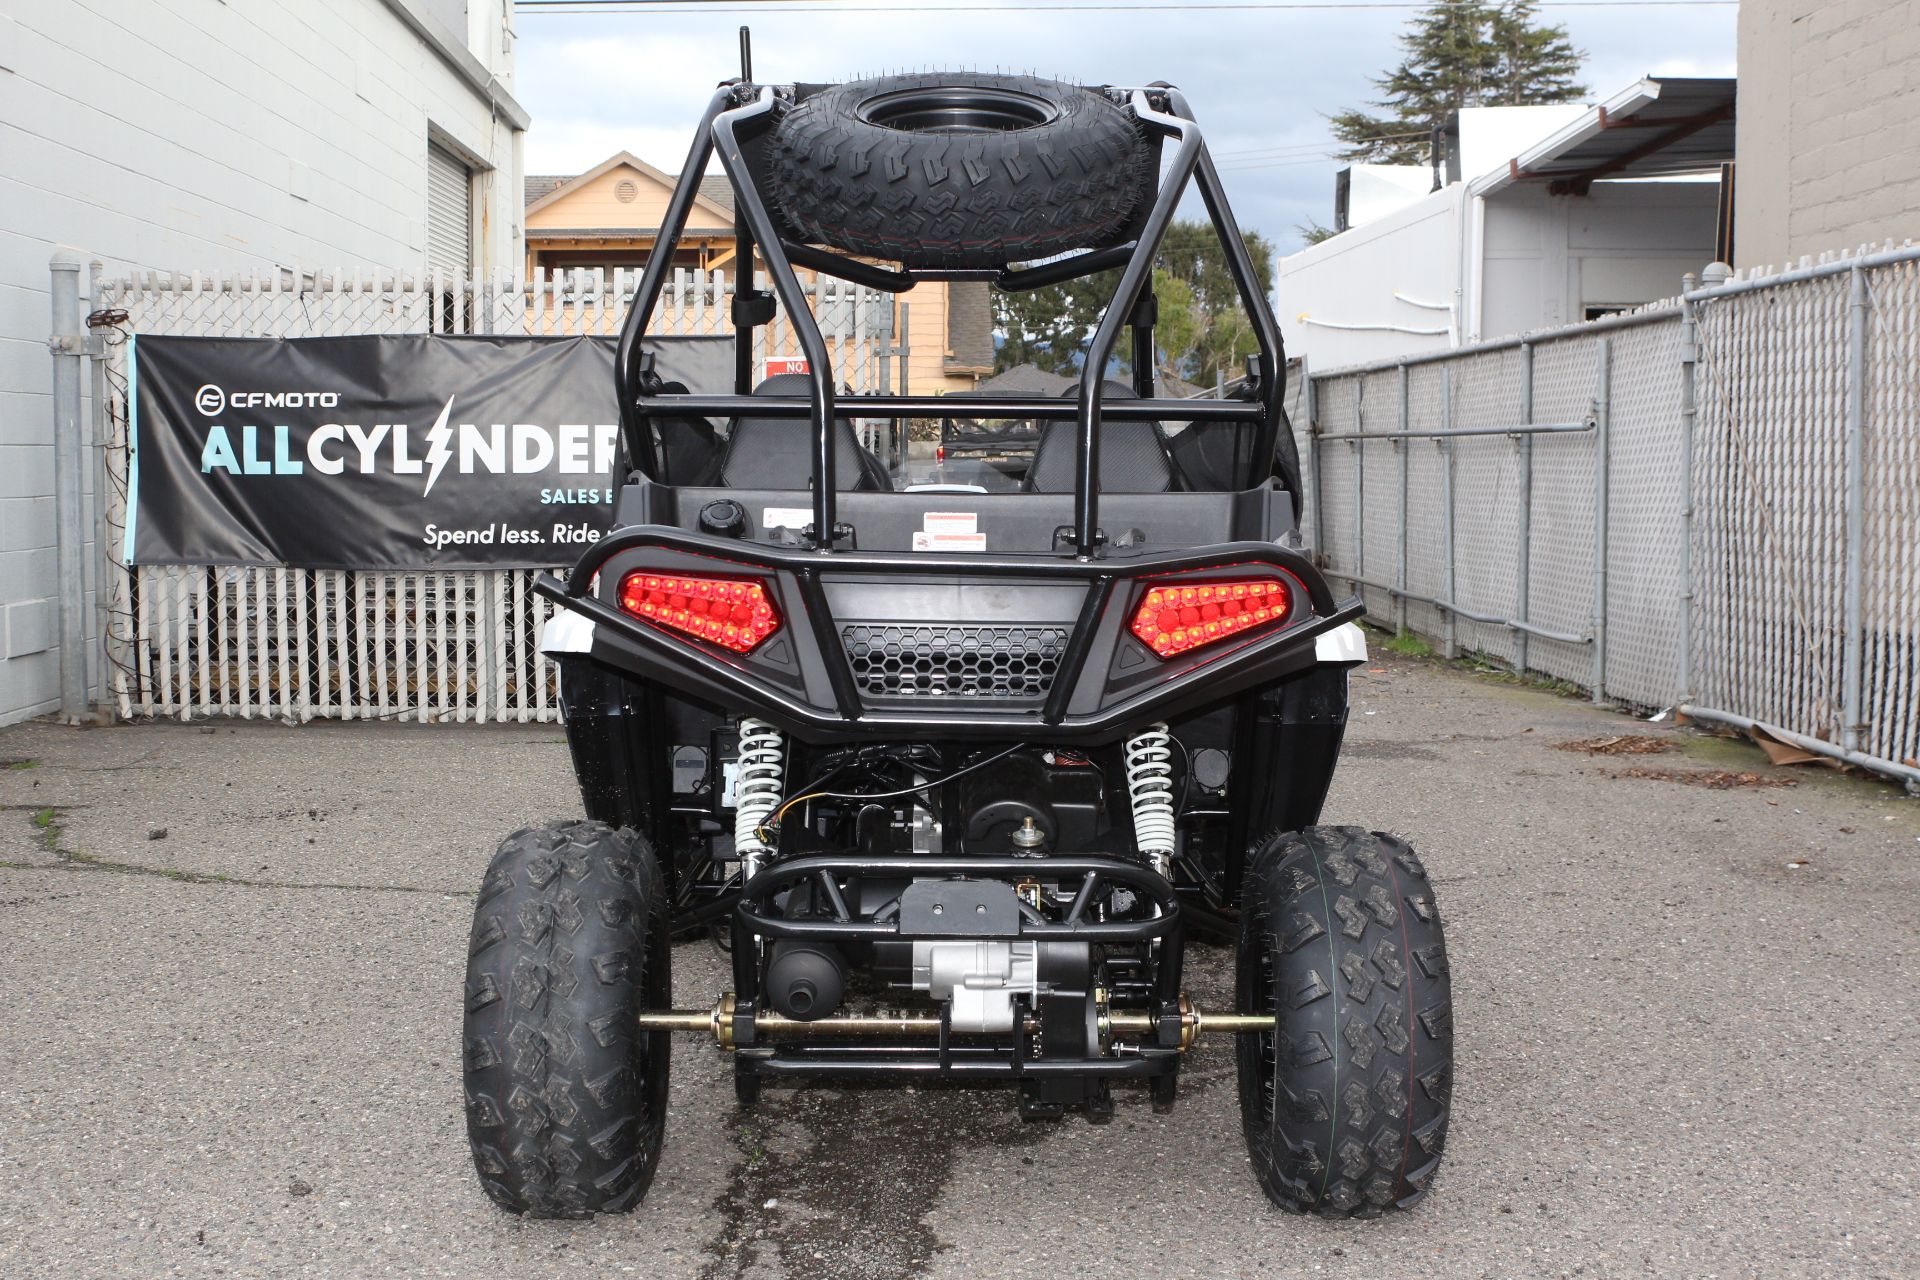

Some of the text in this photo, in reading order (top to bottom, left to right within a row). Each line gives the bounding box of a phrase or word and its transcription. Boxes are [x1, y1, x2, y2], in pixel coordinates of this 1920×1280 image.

[786, 361, 804, 373] NO
[230, 392, 338, 408] CFMOTO
[540, 488, 600, 504] SALES
[423, 523, 600, 550] Spend less. Ride
